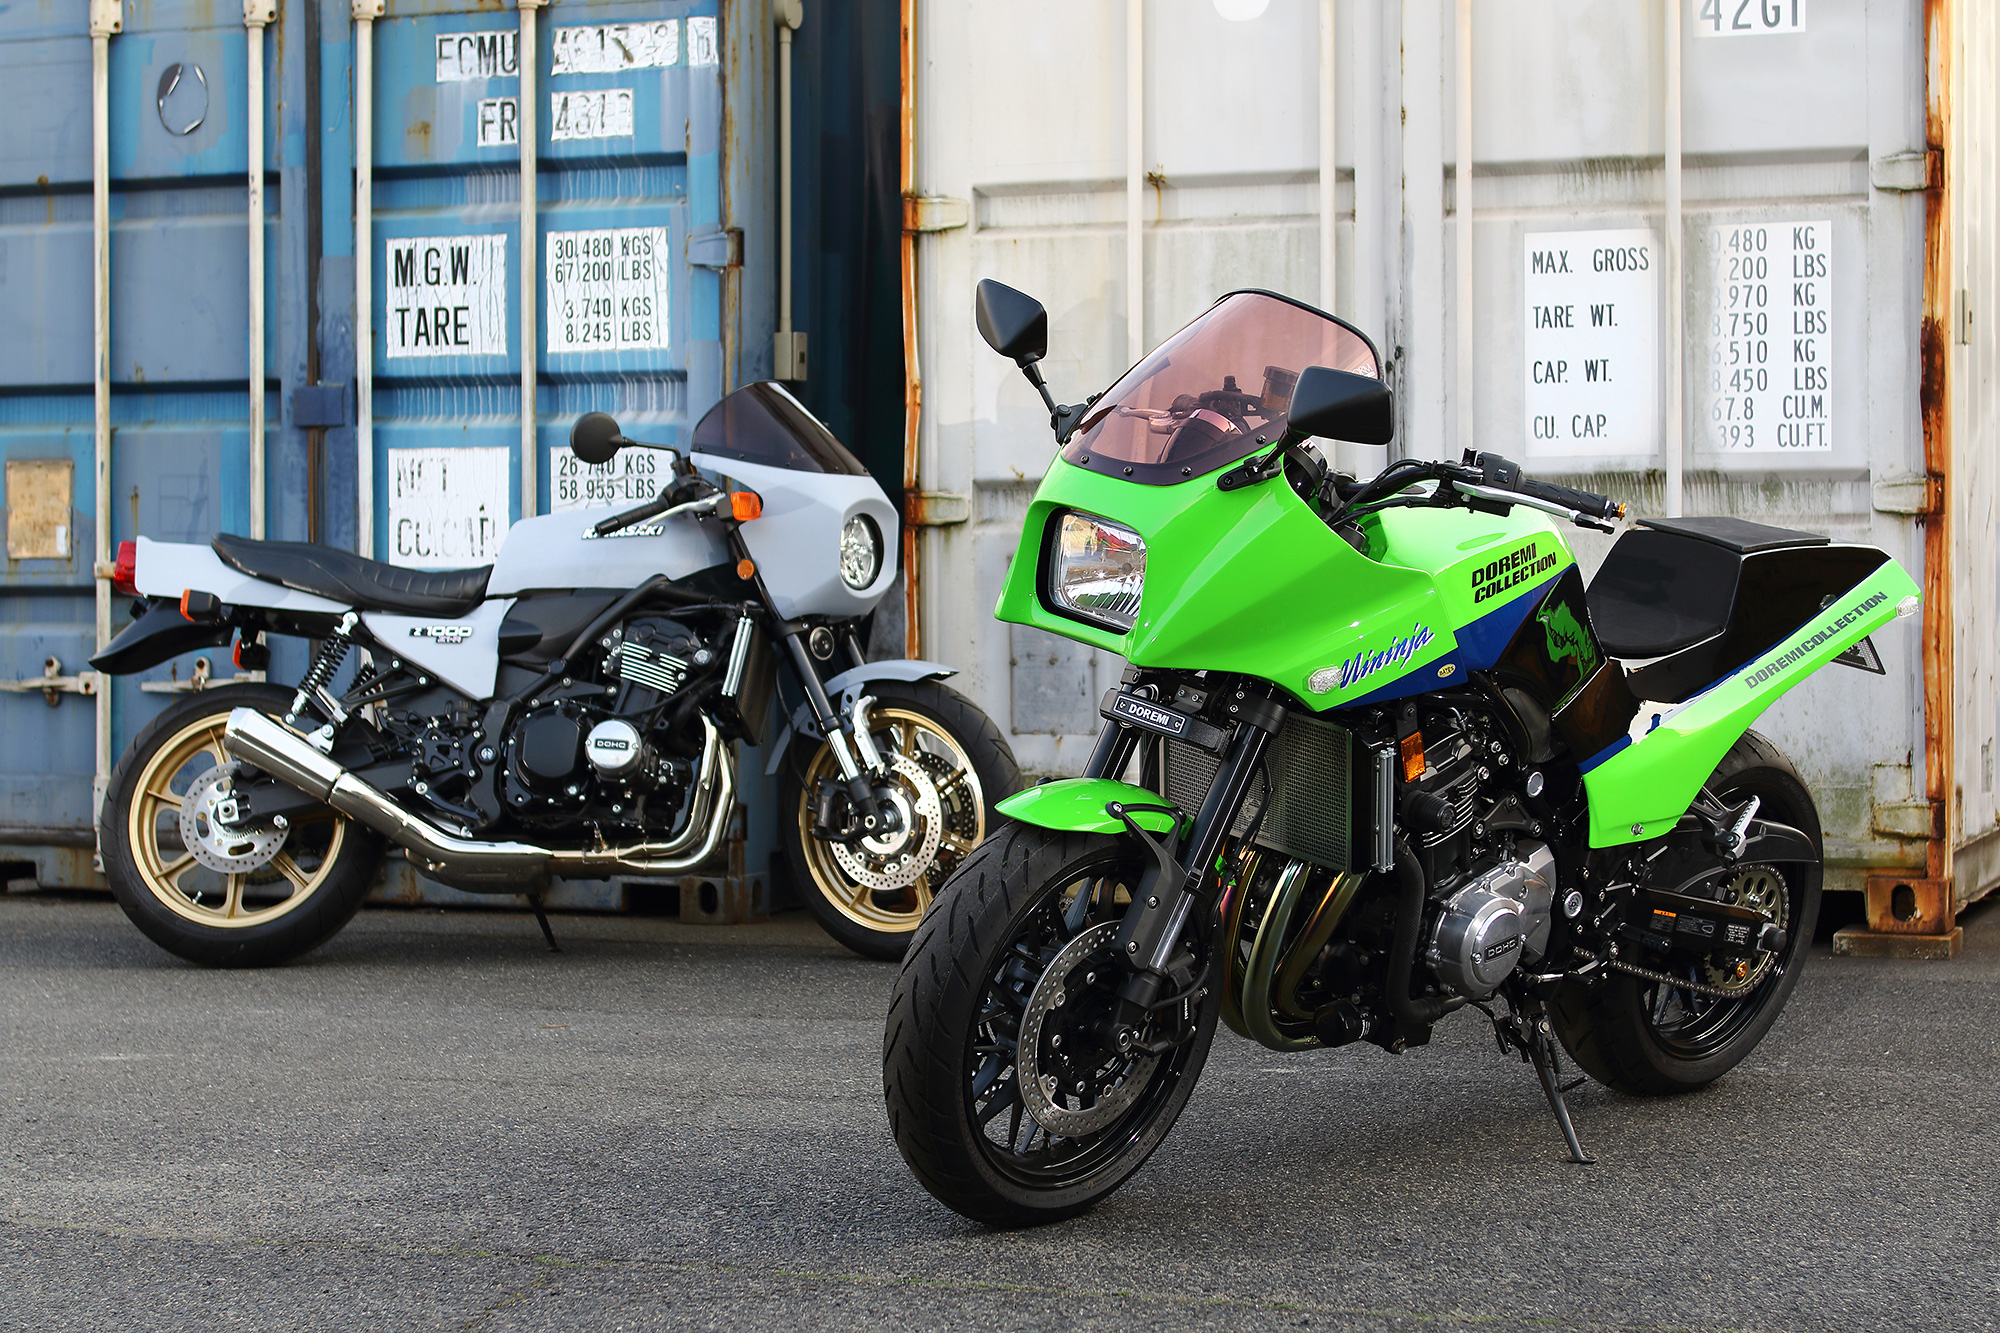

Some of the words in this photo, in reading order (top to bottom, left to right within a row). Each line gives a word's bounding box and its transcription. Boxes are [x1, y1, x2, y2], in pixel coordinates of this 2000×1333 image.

[482, 102, 516, 142] FR
[621, 235, 652, 256] KGS
[1793, 226, 1815, 251] KG
[394, 246, 477, 287] M.G.W.
[621, 260, 652, 281] LBS
[1532, 250, 1574, 274] MAX.
[1592, 246, 1650, 272] GROSS
[1792, 253, 1827, 278] LBS
[621, 296, 652, 317] KGS
[1793, 282, 1816, 307] KG
[395, 306, 470, 347] TARE
[1532, 304, 1574, 329] TARE
[1590, 303, 1618, 327] WT.
[1793, 310, 1828, 335] LBS
[621, 321, 652, 342] LBS
[1793, 338, 1816, 363] KG
[1533, 360, 1569, 384] CAP.
[1585, 359, 1612, 383] WT.
[1793, 366, 1828, 391] LBS
[1782, 395, 1828, 420] CU.M.
[1533, 415, 1560, 439] CU.
[1572, 414, 1608, 439] CAP.
[1777, 423, 1828, 448] CU.FT.
[625, 454, 655, 475] KGS
[625, 478, 655, 499] LBS
[1471, 542, 1537, 588] DOREMI
[1474, 552, 1557, 604] COLLECTION
[1128, 703, 1171, 726] DOREMI
[1487, 939, 1517, 957] DOHC
